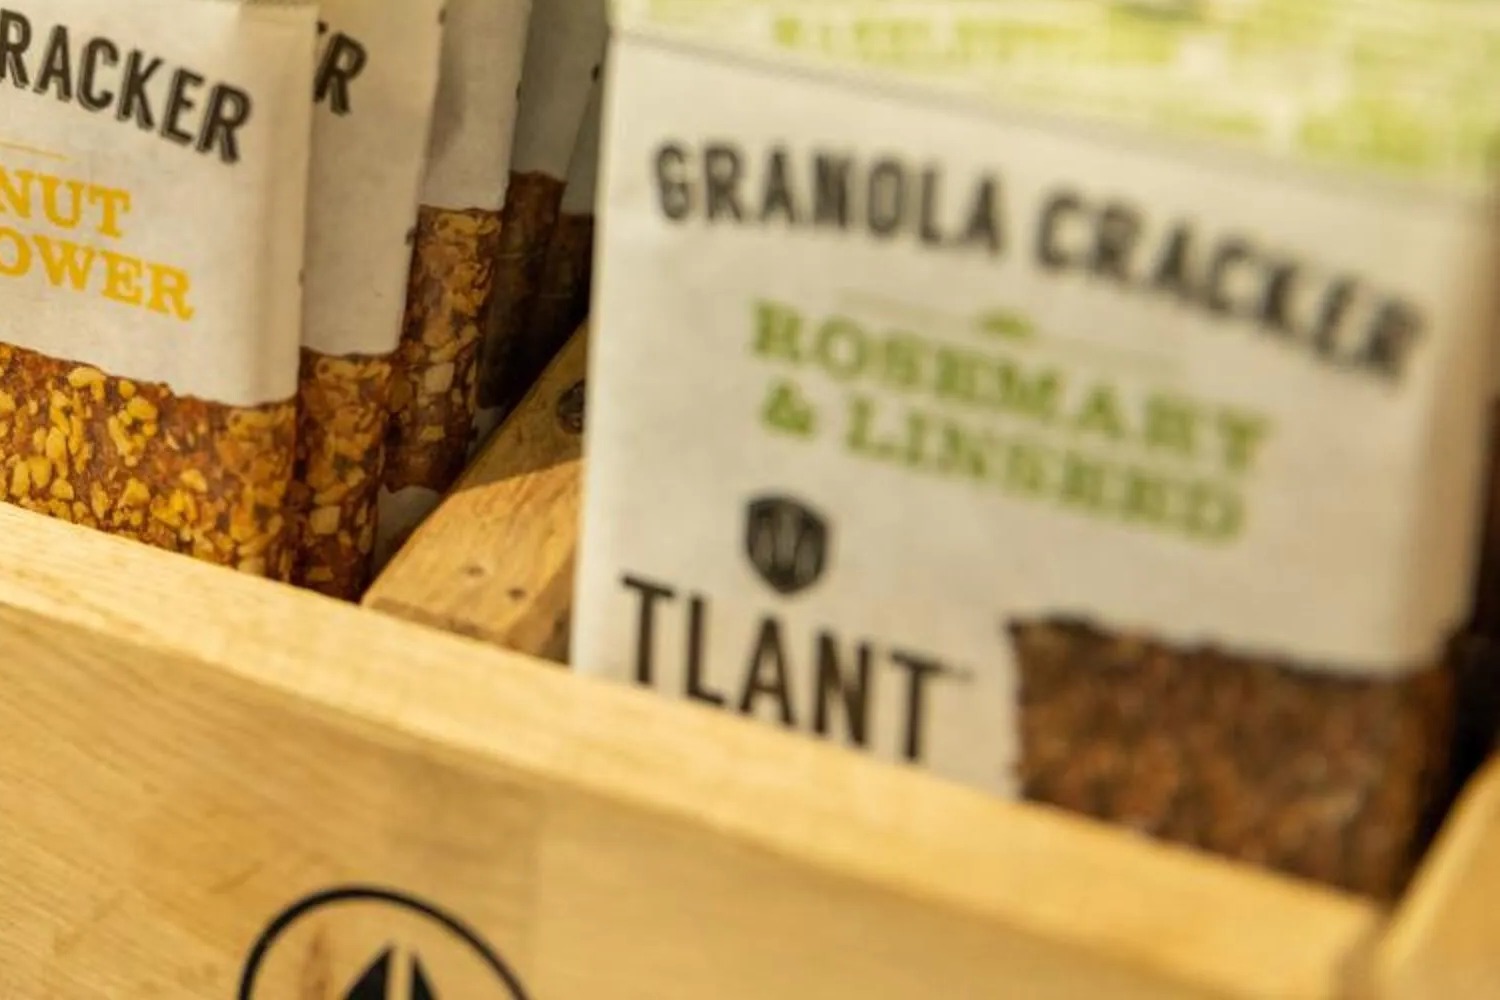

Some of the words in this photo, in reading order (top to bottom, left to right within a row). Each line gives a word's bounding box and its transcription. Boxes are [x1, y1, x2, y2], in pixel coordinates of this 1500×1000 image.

[650, 138, 1007, 258] GRANOLA
[1033, 187, 1427, 384] CRACKER
[749, 298, 1272, 475] ROSEMARY
[761, 378, 819, 440] &
[844, 399, 1248, 545] LINSEED
[620, 572, 946, 765] TLANT
